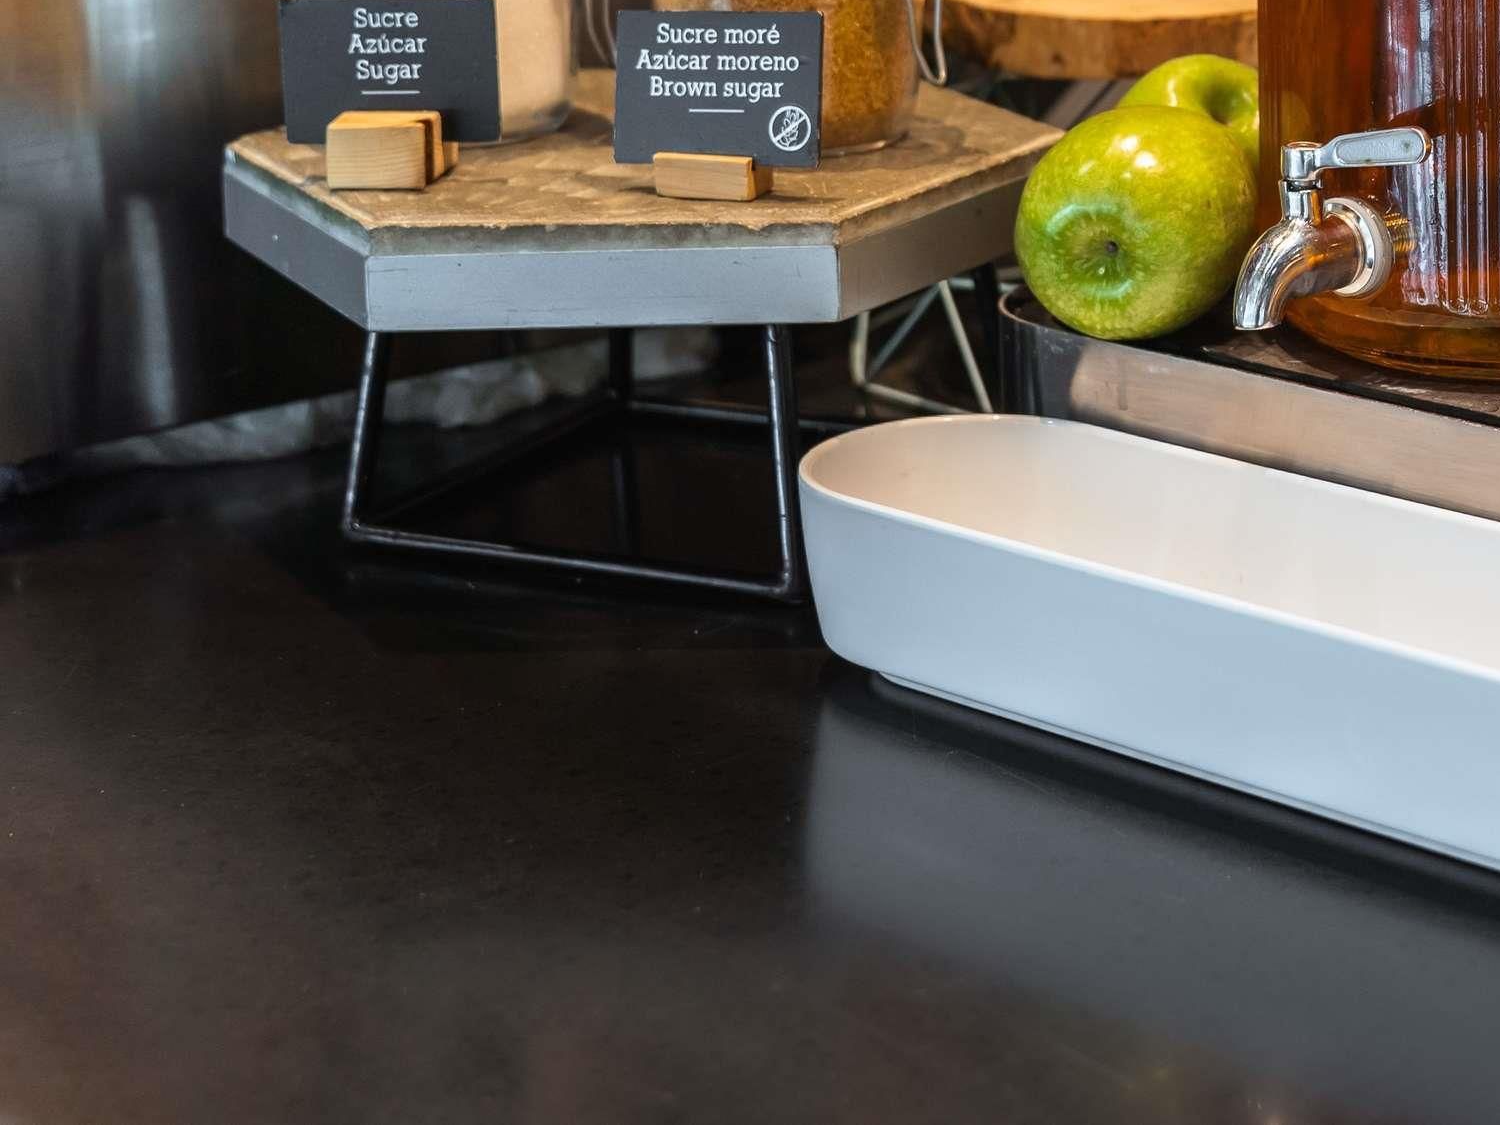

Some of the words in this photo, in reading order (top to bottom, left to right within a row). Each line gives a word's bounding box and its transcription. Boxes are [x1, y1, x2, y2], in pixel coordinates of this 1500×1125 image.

[353, 7, 419, 29] Sucre
[347, 33, 428, 55] Azúcar
[656, 22, 717, 44] Sucre
[724, 23, 780, 44] moré
[635, 49, 711, 70] Azúcar
[717, 55, 800, 72] moreno
[355, 59, 422, 85] Sugar
[650, 76, 717, 97] Brown
[723, 81, 784, 103] sugar
